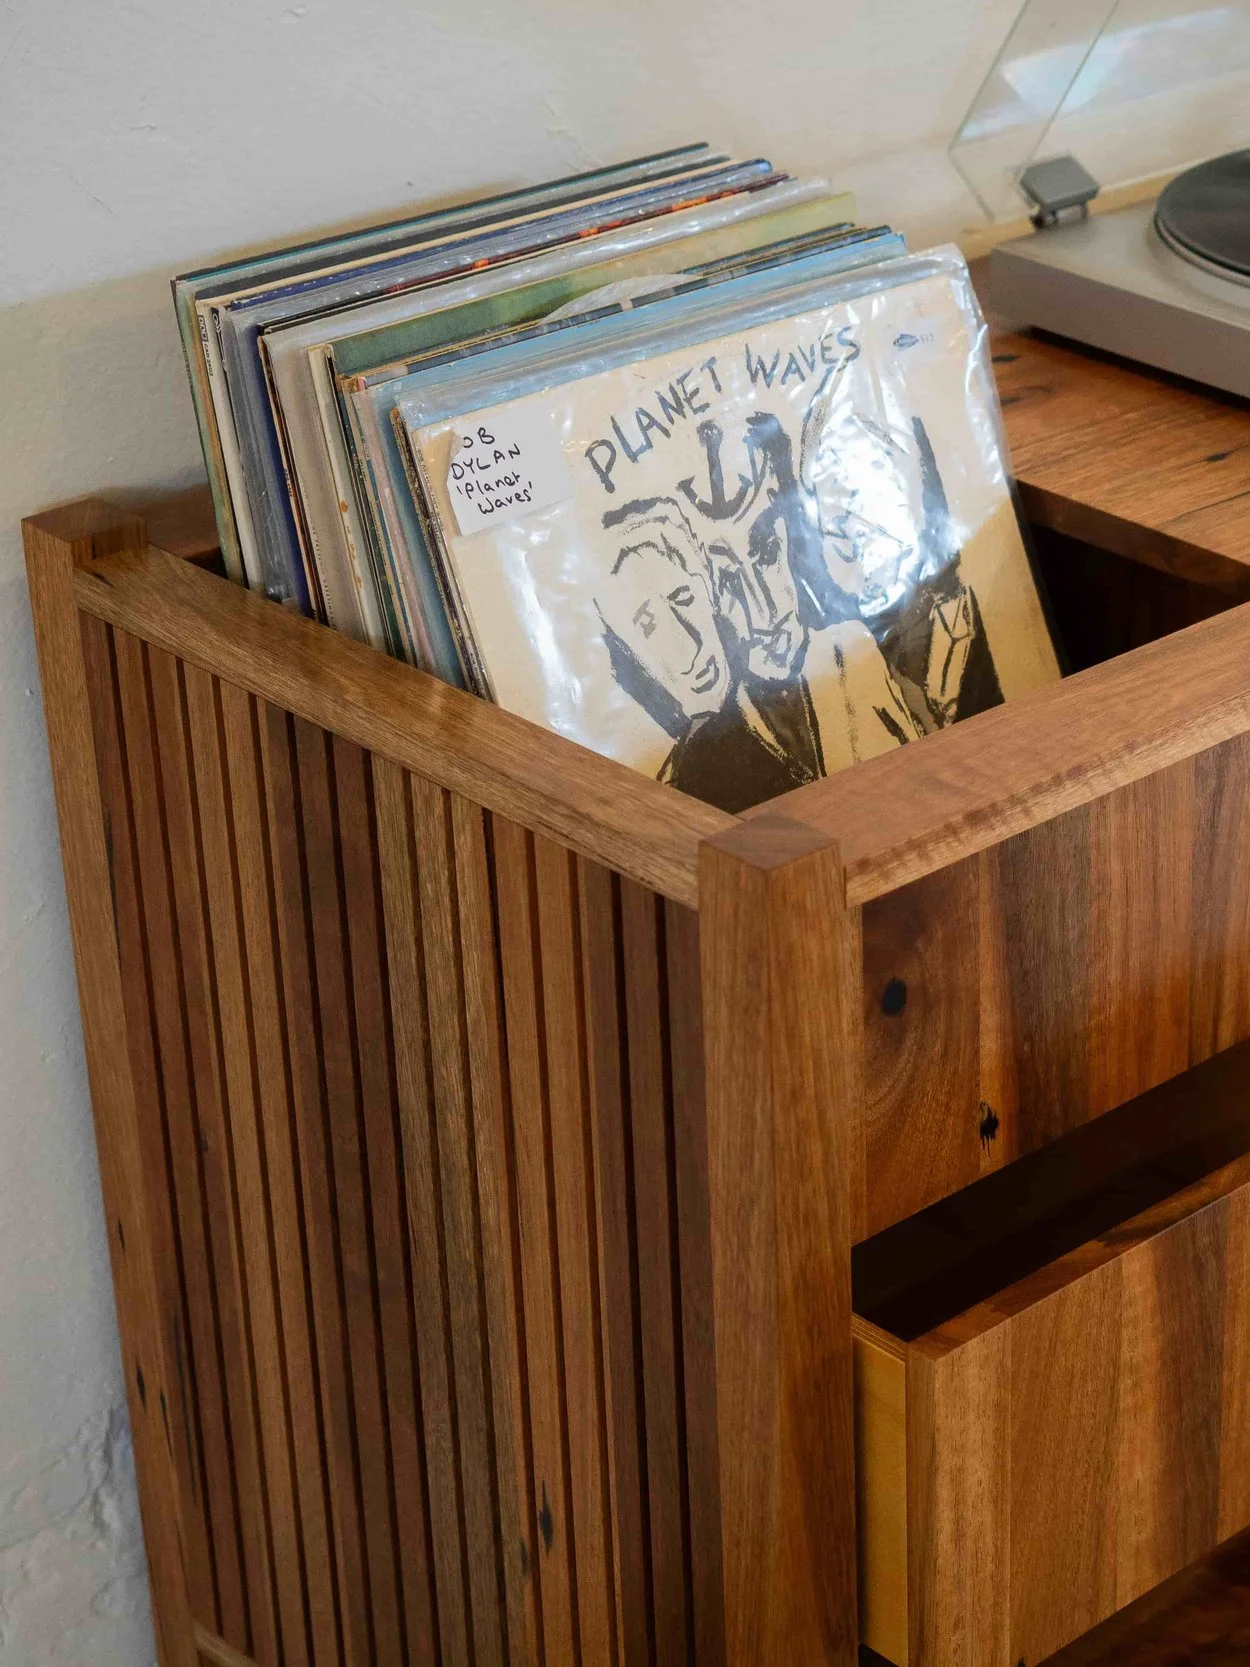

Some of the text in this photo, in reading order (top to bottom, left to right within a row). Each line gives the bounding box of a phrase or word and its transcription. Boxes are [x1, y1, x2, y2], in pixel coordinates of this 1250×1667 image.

[584, 326, 861, 494] PLANET WAVES
[450, 443, 522, 481] DYLAN
